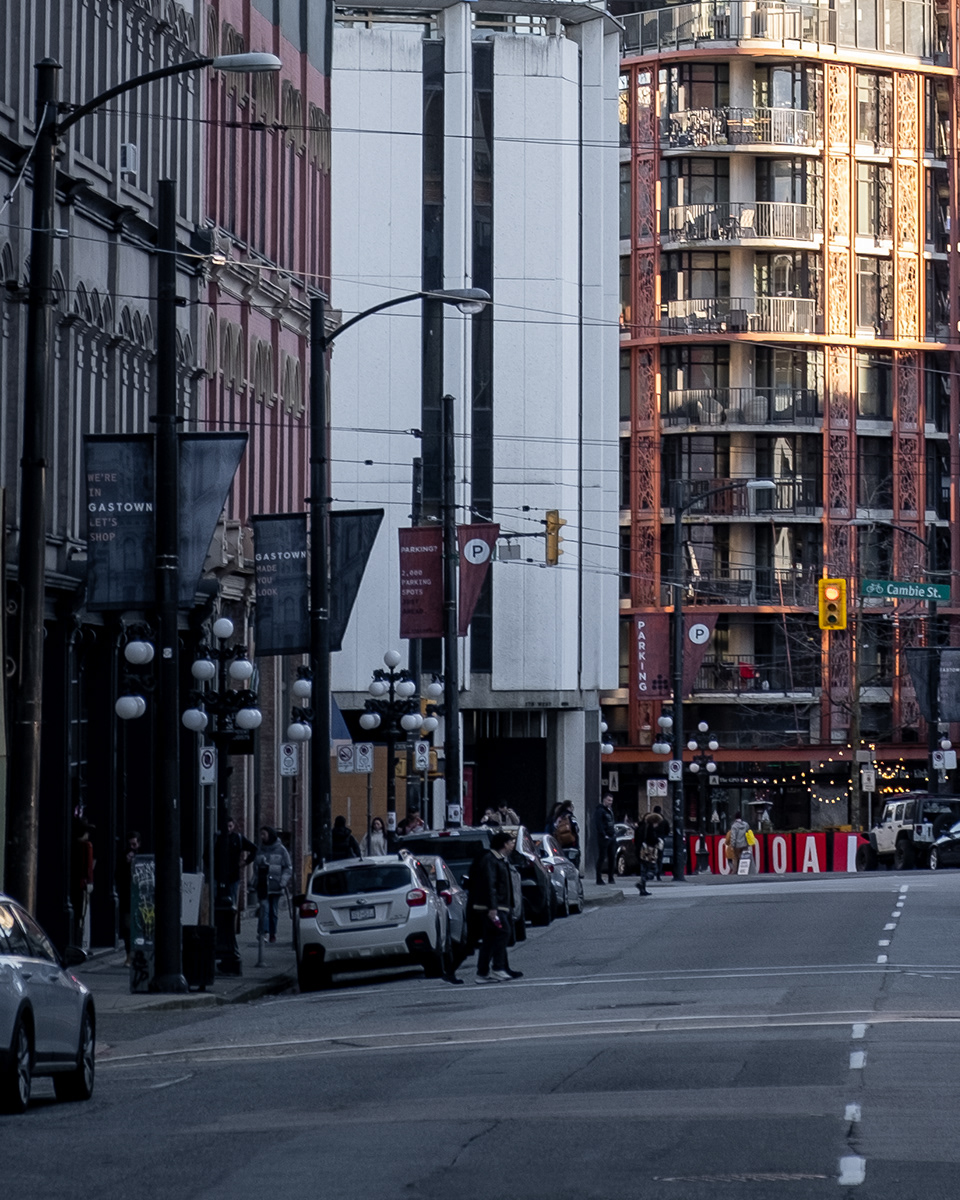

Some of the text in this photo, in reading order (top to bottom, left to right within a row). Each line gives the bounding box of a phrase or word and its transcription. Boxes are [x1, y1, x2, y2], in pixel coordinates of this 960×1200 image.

[87, 473, 117, 482] WE'RE
[88, 488, 101, 497] IN
[88, 502, 153, 512] GASTOWN
[89, 518, 118, 527] LET'S
[90, 532, 116, 542] SHOP
[401, 545, 438, 553] PARKING?
[472, 545, 483, 558] P
[255, 551, 307, 562] GASTOWN
[256, 564, 277, 572] MADE
[401, 569, 423, 577] 2,000
[256, 576, 273, 584] YOU
[401, 578, 432, 586] PARKING
[257, 588, 278, 597] LOOK
[401, 588, 423, 596] SPOTS
[886, 584, 942, 599] Cambie St.
[695, 628, 704, 640] P
[637, 620, 647, 691] PARKING
